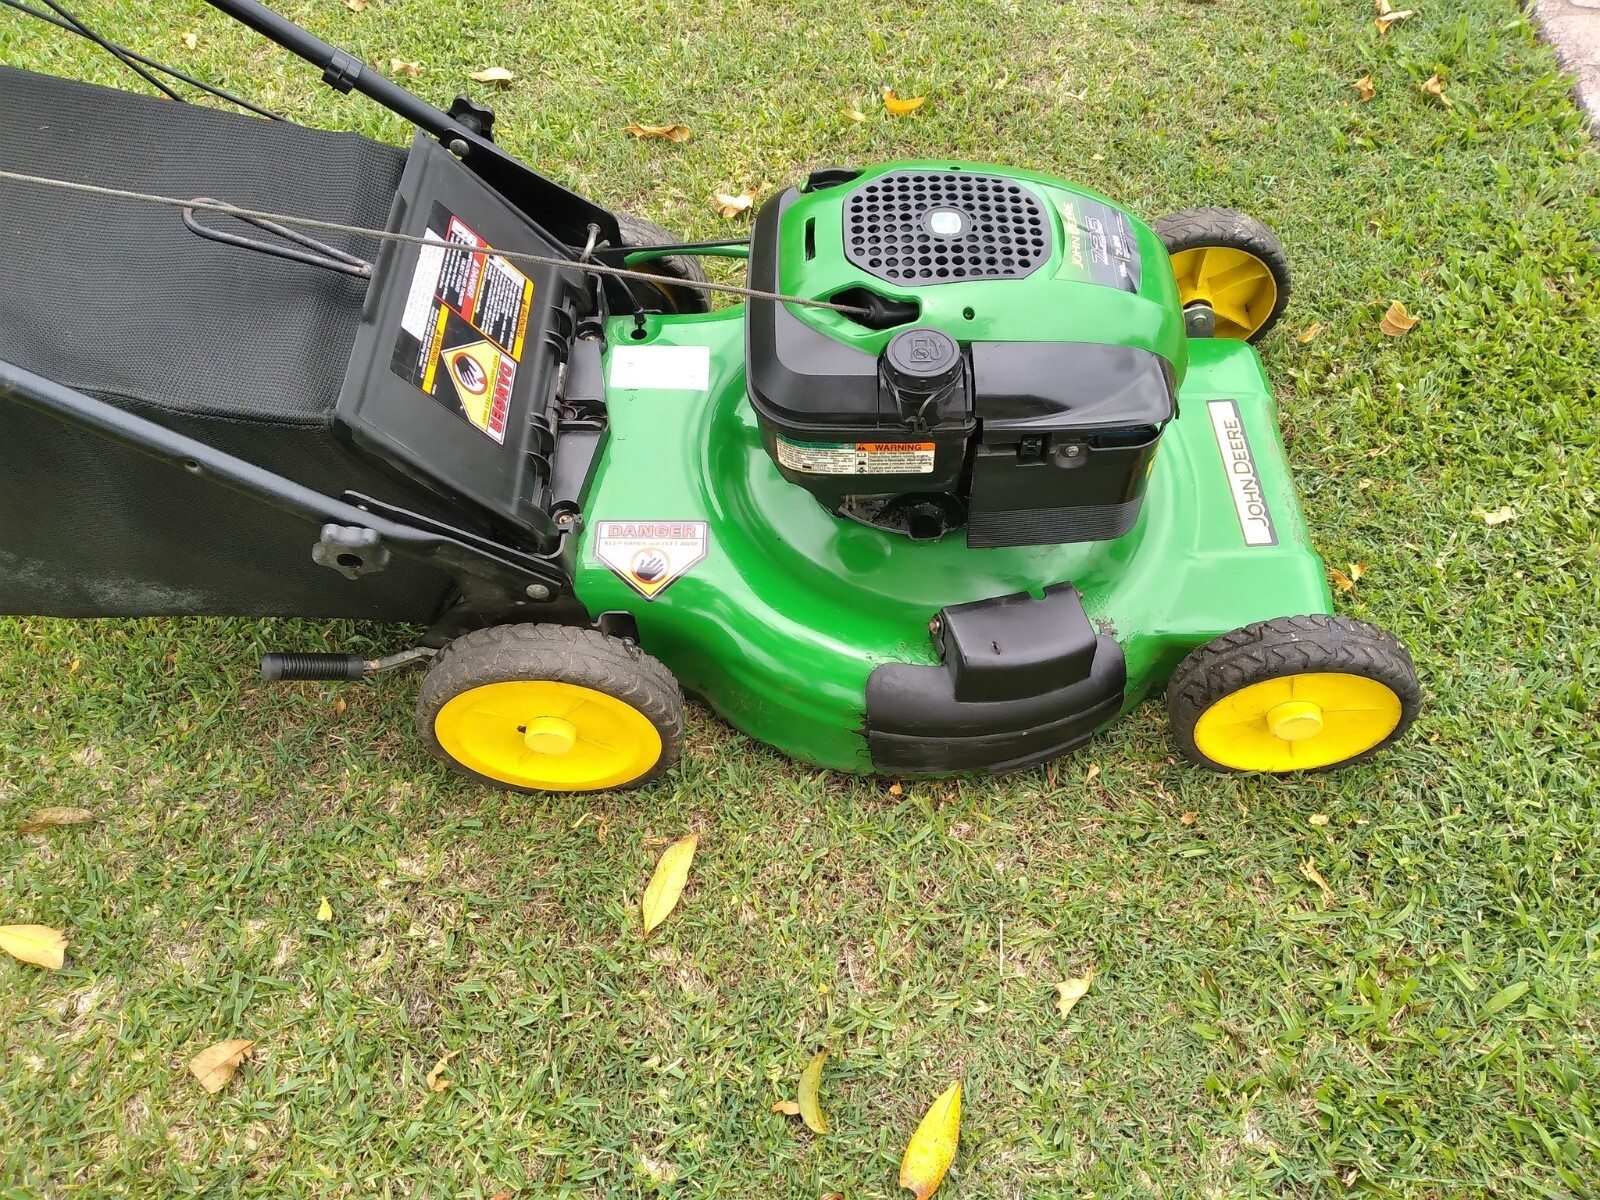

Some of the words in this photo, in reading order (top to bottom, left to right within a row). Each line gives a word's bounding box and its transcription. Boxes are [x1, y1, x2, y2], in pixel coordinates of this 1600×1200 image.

[1063, 201, 1080, 235] DEERE
[1071, 235, 1084, 269] JOHN
[1085, 216, 1109, 265] 725
[465, 265, 479, 299] DANGER
[516, 305, 528, 339] WARNING
[429, 335, 441, 367] WARNING
[488, 360, 513, 435] DANGER
[1224, 419, 1252, 475] DEERE
[1240, 477, 1267, 527] JOHN
[608, 525, 696, 538] DANGER
